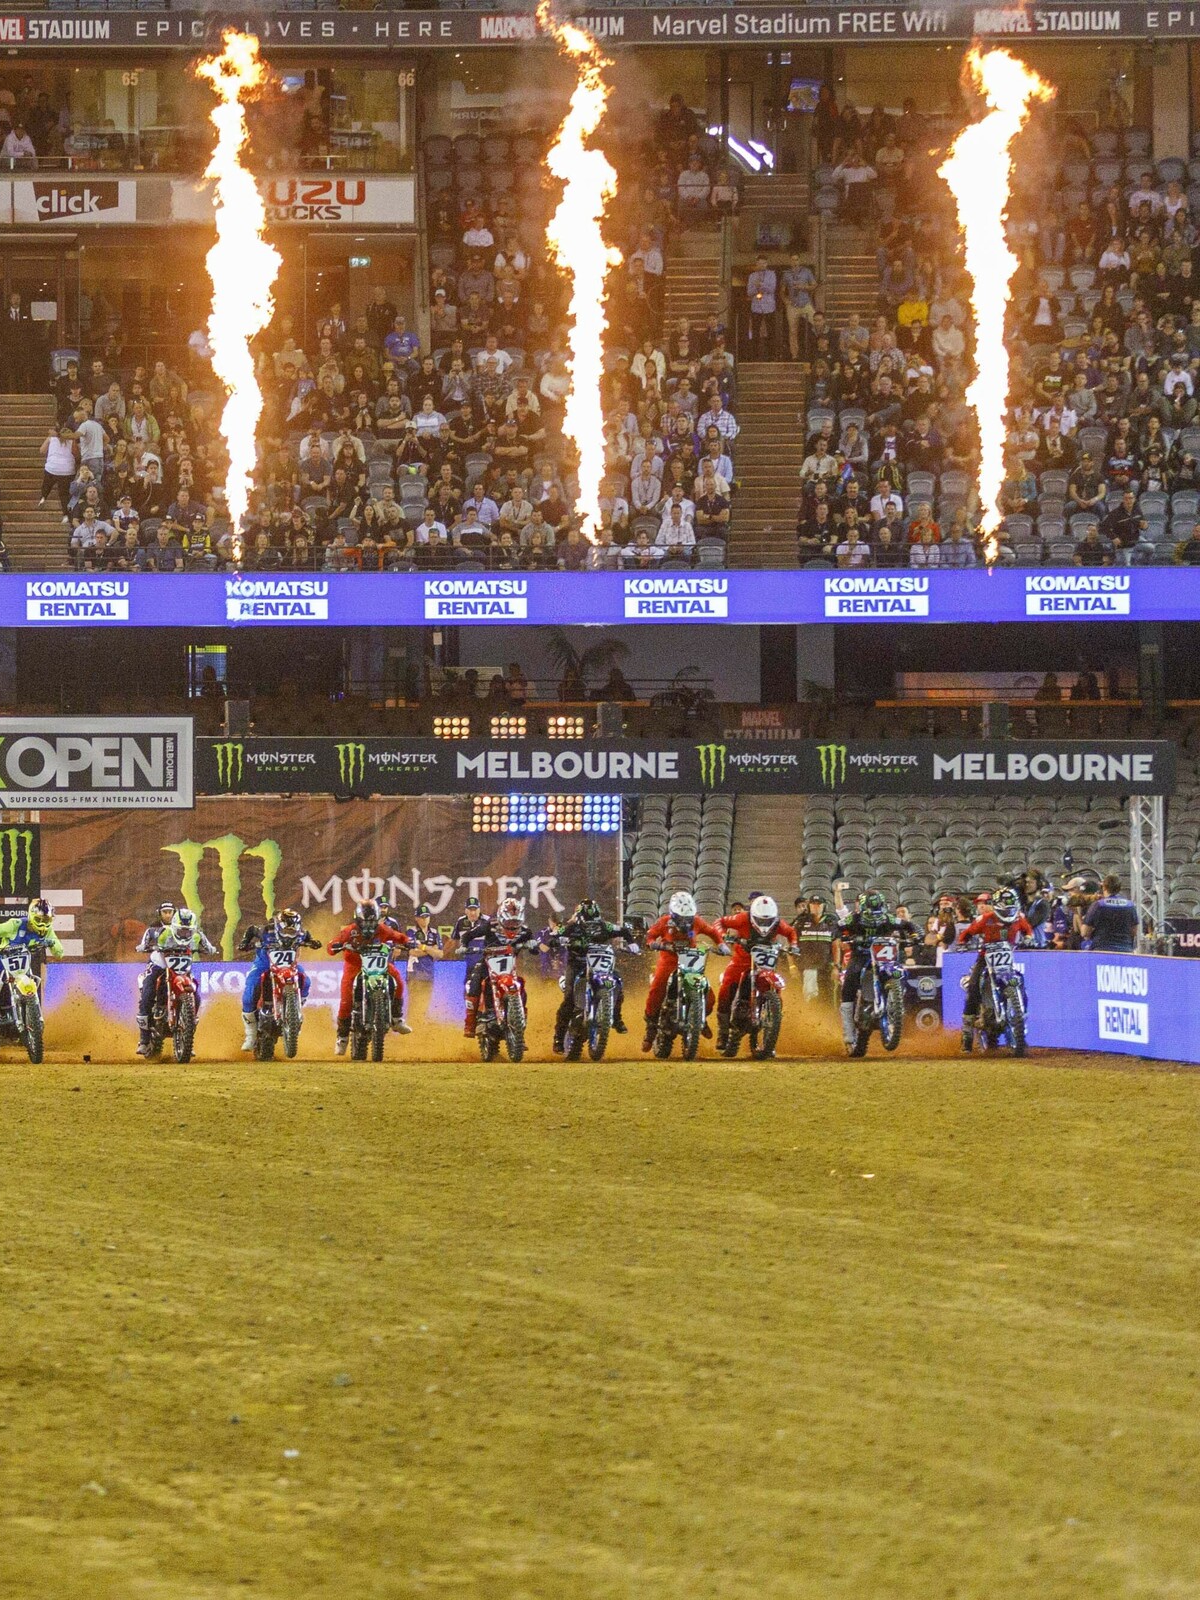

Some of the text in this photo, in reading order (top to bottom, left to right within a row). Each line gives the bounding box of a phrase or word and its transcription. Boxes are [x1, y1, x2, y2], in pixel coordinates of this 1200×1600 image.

[653, 14, 727, 36] Marvel
[735, 12, 830, 35] Stadium
[839, 12, 896, 33] FREE
[1035, 10, 1121, 32] STADIUM
[28, 20, 110, 40] STADIUM
[136, 21, 205, 38] EPIC
[375, 21, 453, 38] HERE
[121, 71, 139, 86] 65
[397, 72, 415, 87] 66
[268, 180, 366, 206] UZU
[35, 188, 101, 214] click
[26, 581, 129, 597] KOMATSU
[226, 581, 328, 597] KOMATSU
[424, 580, 528, 596] KOMATSU
[624, 578, 728, 595] KOMATSU
[824, 577, 929, 593] KOMATSU
[1025, 575, 1130, 592] KOMATSU
[40, 602, 116, 617] RENTAL
[240, 602, 315, 617] RENTAL
[438, 601, 514, 616] RENTAL
[637, 600, 714, 614] RENTAL
[838, 599, 916, 614] RENTAL
[1039, 597, 1116, 612] RENTAL
[5, 736, 164, 789] OPEN
[166, 737, 175, 788] MELBOURNE
[246, 751, 317, 765] MONSTER
[368, 751, 438, 765] MONSTER
[456, 751, 679, 779] MELBOURNE
[729, 752, 799, 766] MONSTER
[850, 753, 919, 767] MONSTER
[932, 753, 1153, 782] MELBOURNE
[9, 795, 69, 804] SUPERCROSS
[79, 795, 99, 804] FMX
[101, 795, 175, 804] INTERNATIONAL
[300, 867, 566, 915] MONSTER
[273, 951, 294, 966] 24
[589, 954, 612, 969] 75
[685, 953, 700, 968] 7
[755, 953, 777, 967] 30
[875, 947, 895, 961] 4
[988, 951, 1011, 967] 122
[8, 955, 28, 971] 57
[167, 957, 192, 972] 22
[366, 955, 387, 969] 70
[495, 957, 508, 972] 1
[1096, 964, 1148, 997] KOMATSU
[1104, 1005, 1142, 1036] RENTAL
